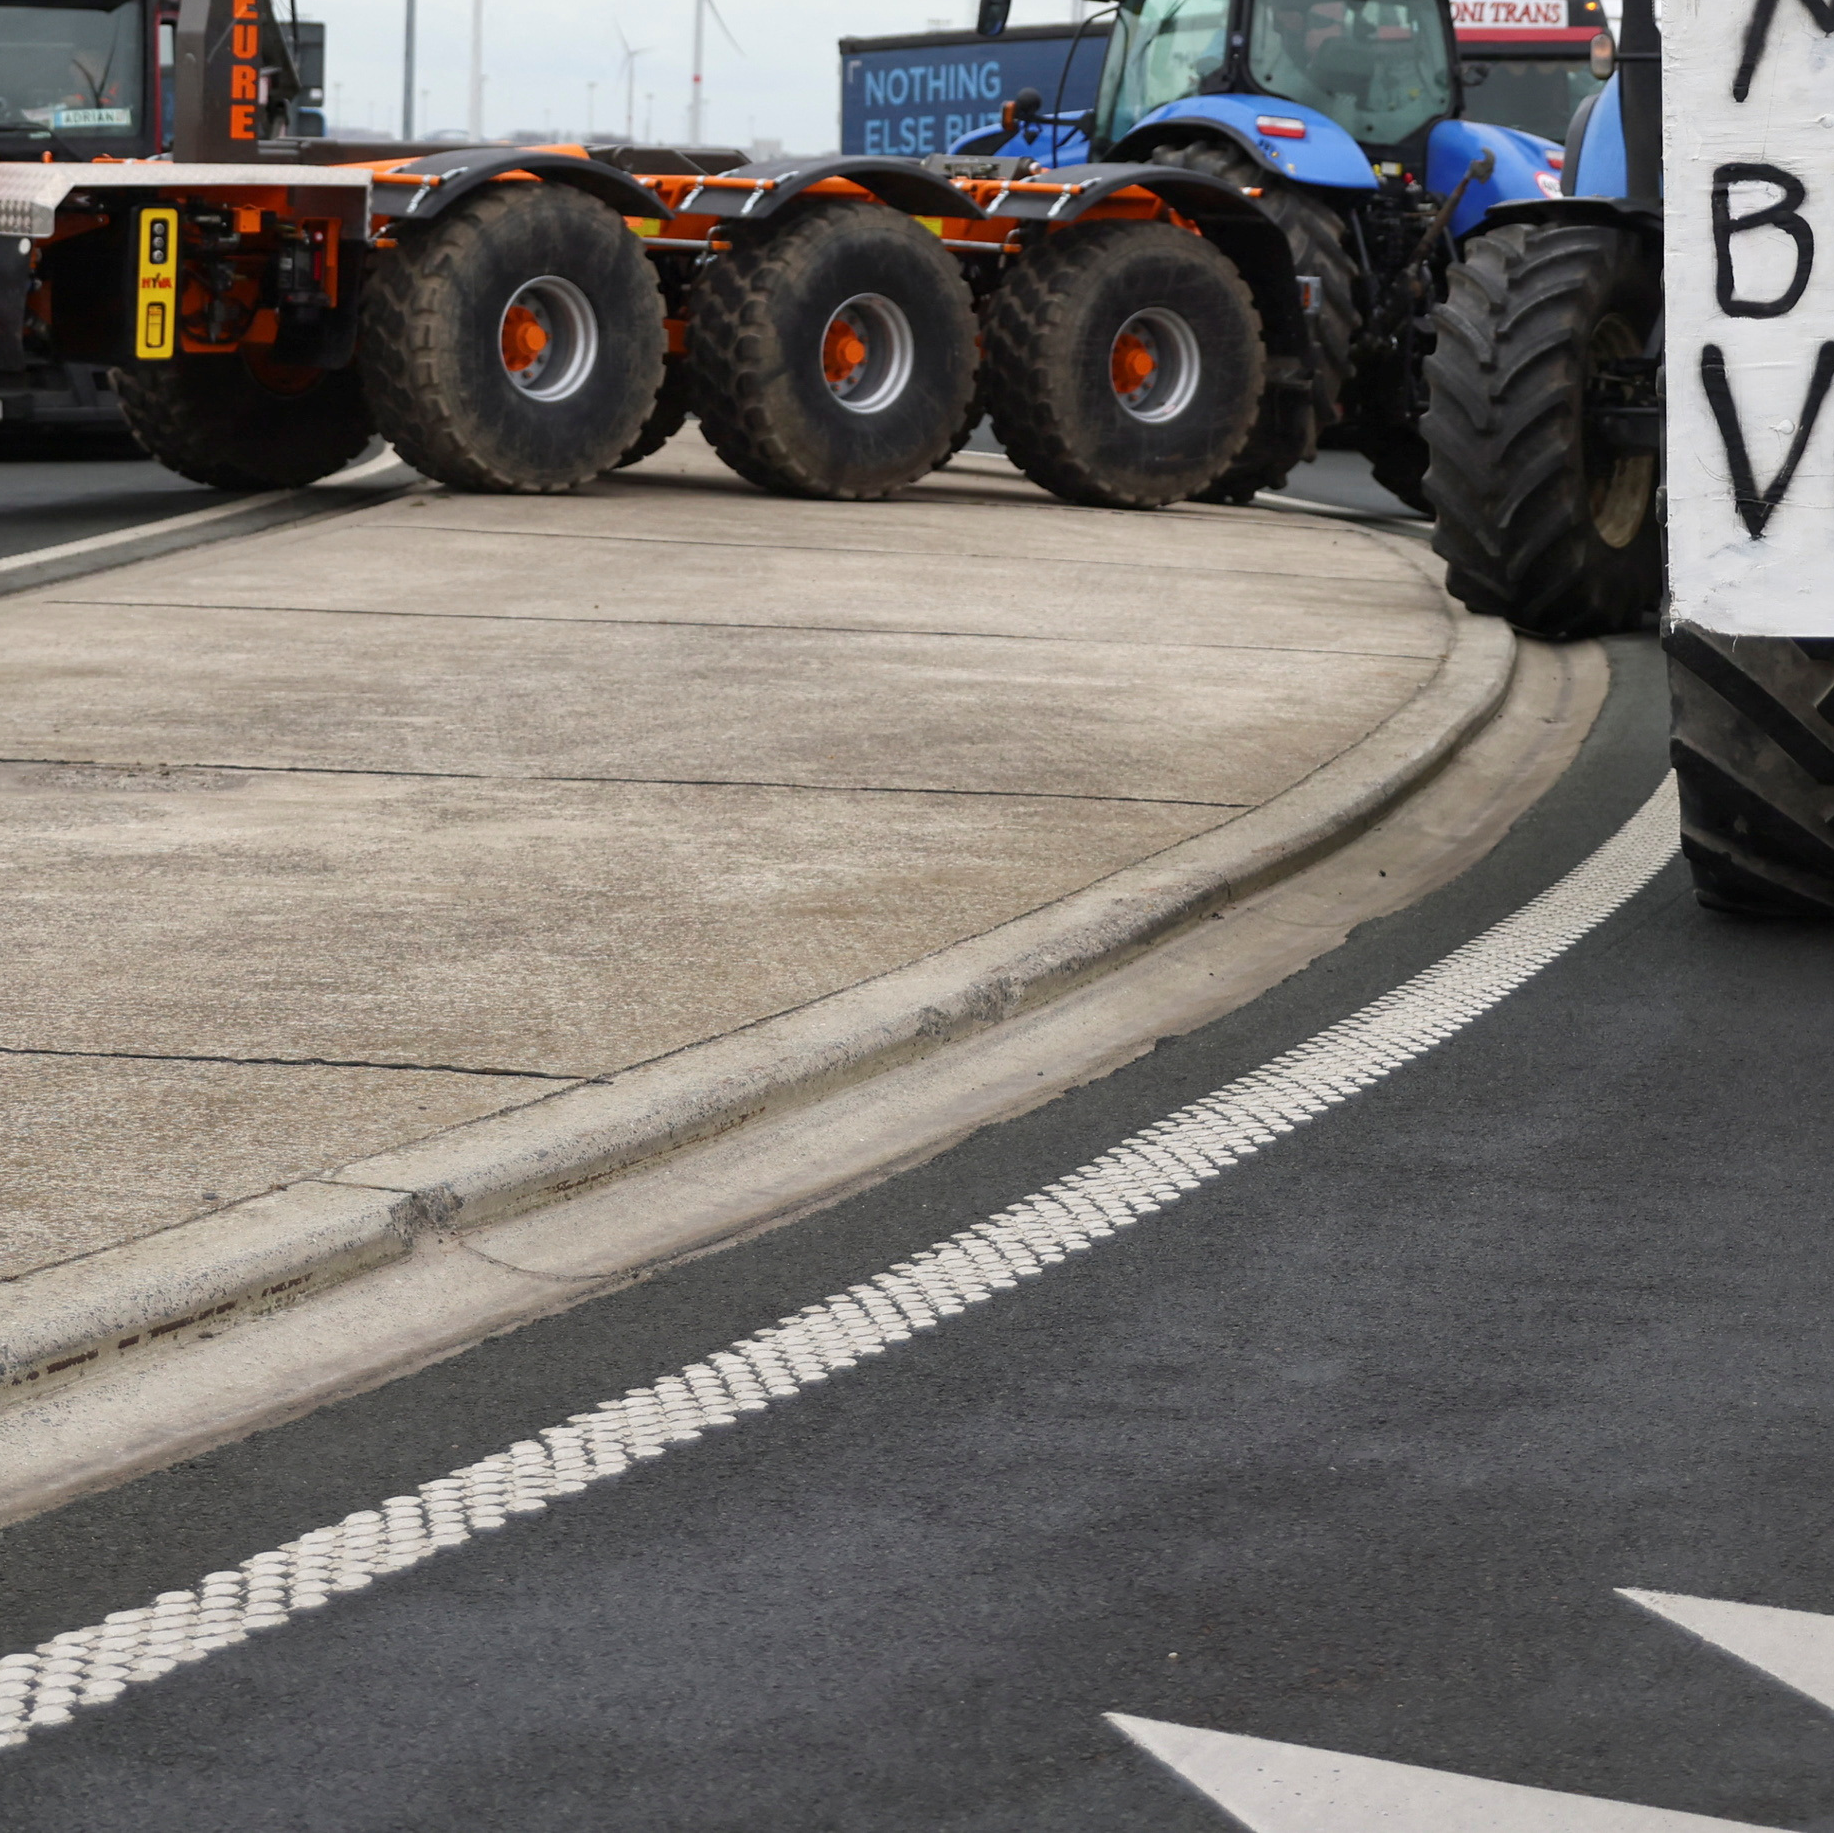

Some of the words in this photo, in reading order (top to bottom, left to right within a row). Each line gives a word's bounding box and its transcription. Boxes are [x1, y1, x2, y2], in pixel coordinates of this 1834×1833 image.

[1492, 2, 1560, 23] TRANS
[864, 60, 1002, 108] NOTHING
[65, 110, 114, 124] ADRIAN
[864, 116, 936, 156] ELSE
